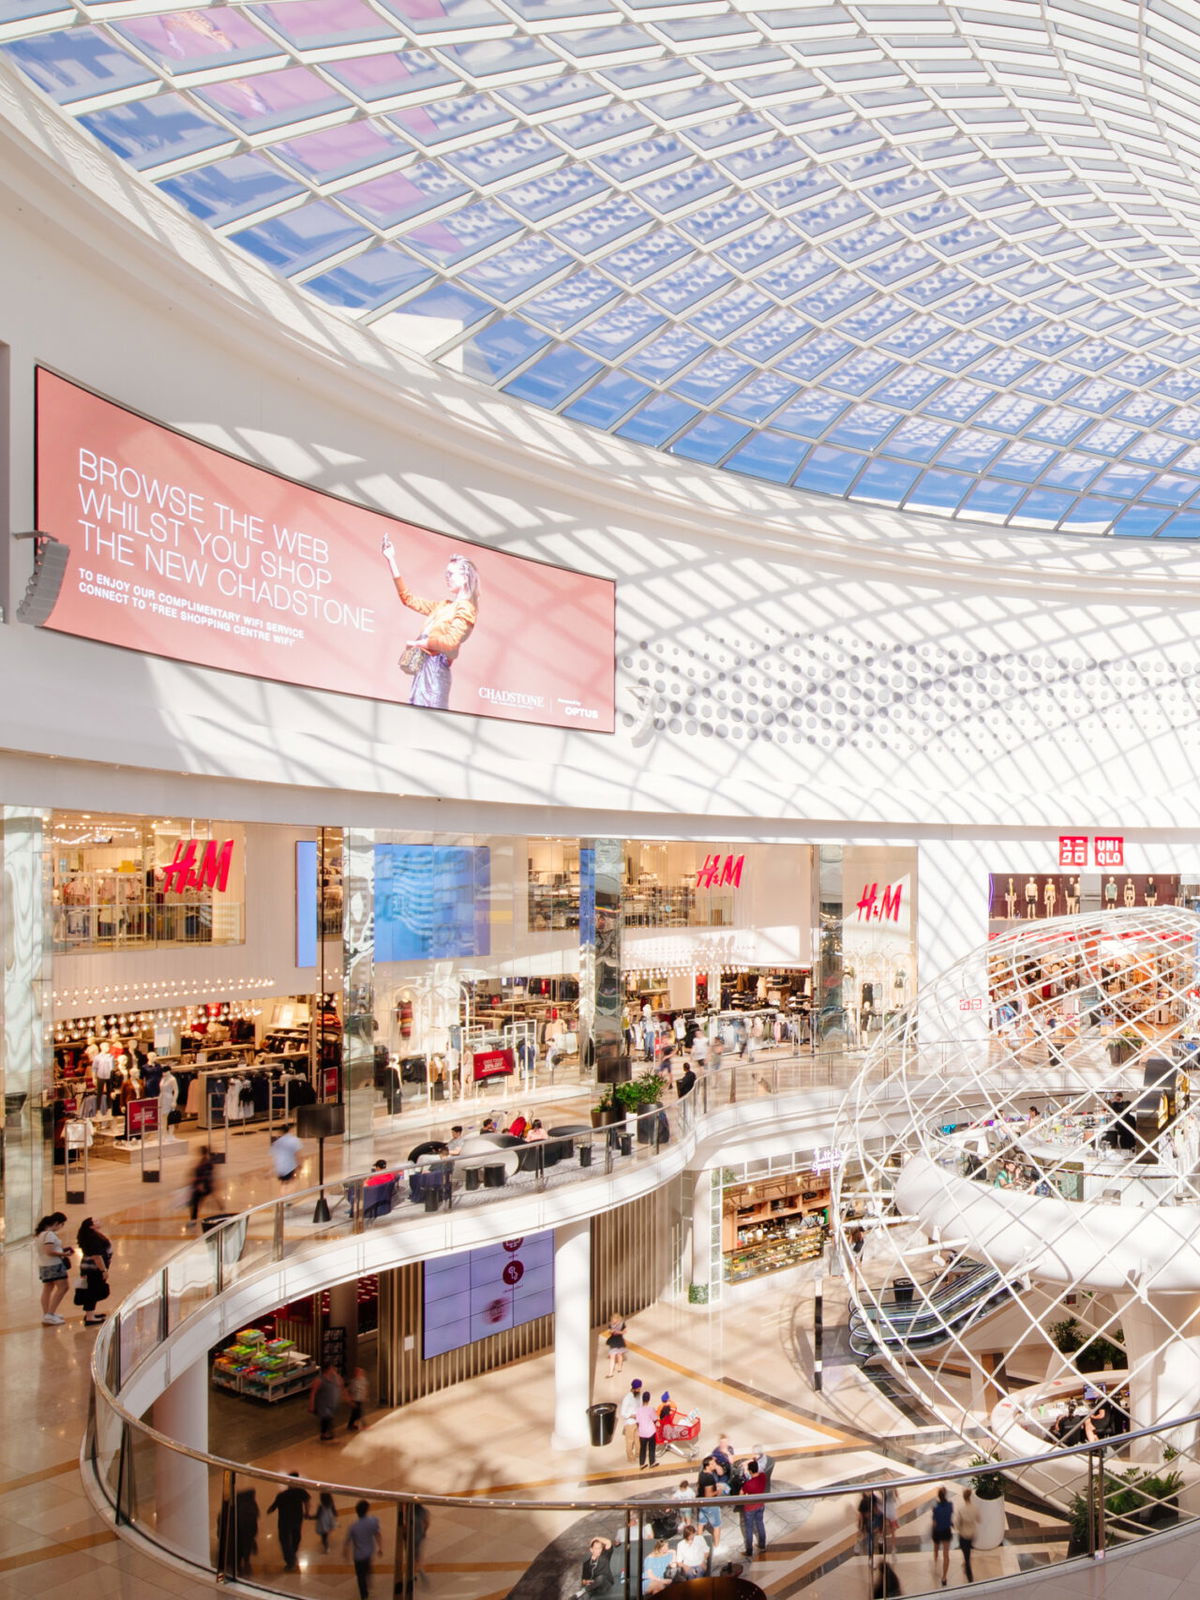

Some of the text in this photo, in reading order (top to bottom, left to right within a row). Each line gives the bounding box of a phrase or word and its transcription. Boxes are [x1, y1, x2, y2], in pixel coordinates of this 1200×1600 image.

[79, 447, 329, 565] BROWSE THE WEB
[78, 483, 333, 592] WHILST YOU SHOP
[78, 519, 376, 633] THE NEW CHADSTONE
[78, 567, 94, 582] TO
[96, 573, 131, 592] ENJOY
[133, 585, 156, 600] OUR
[158, 592, 241, 623] COMPLIMENTARY
[266, 621, 305, 639] SERVICE
[78, 581, 130, 605] CONNECT
[131, 596, 146, 610] TO
[180, 610, 231, 632] SHOPPING
[232, 624, 271, 642] CENTRE
[478, 686, 545, 708] CHADSTONE
[564, 705, 599, 719] OPTUS
[160, 838, 234, 895] H&M
[1097, 839, 1119, 851] UNI
[1097, 852, 1121, 865] QLO
[696, 854, 745, 889] H&M
[856, 882, 902, 922] H&M
